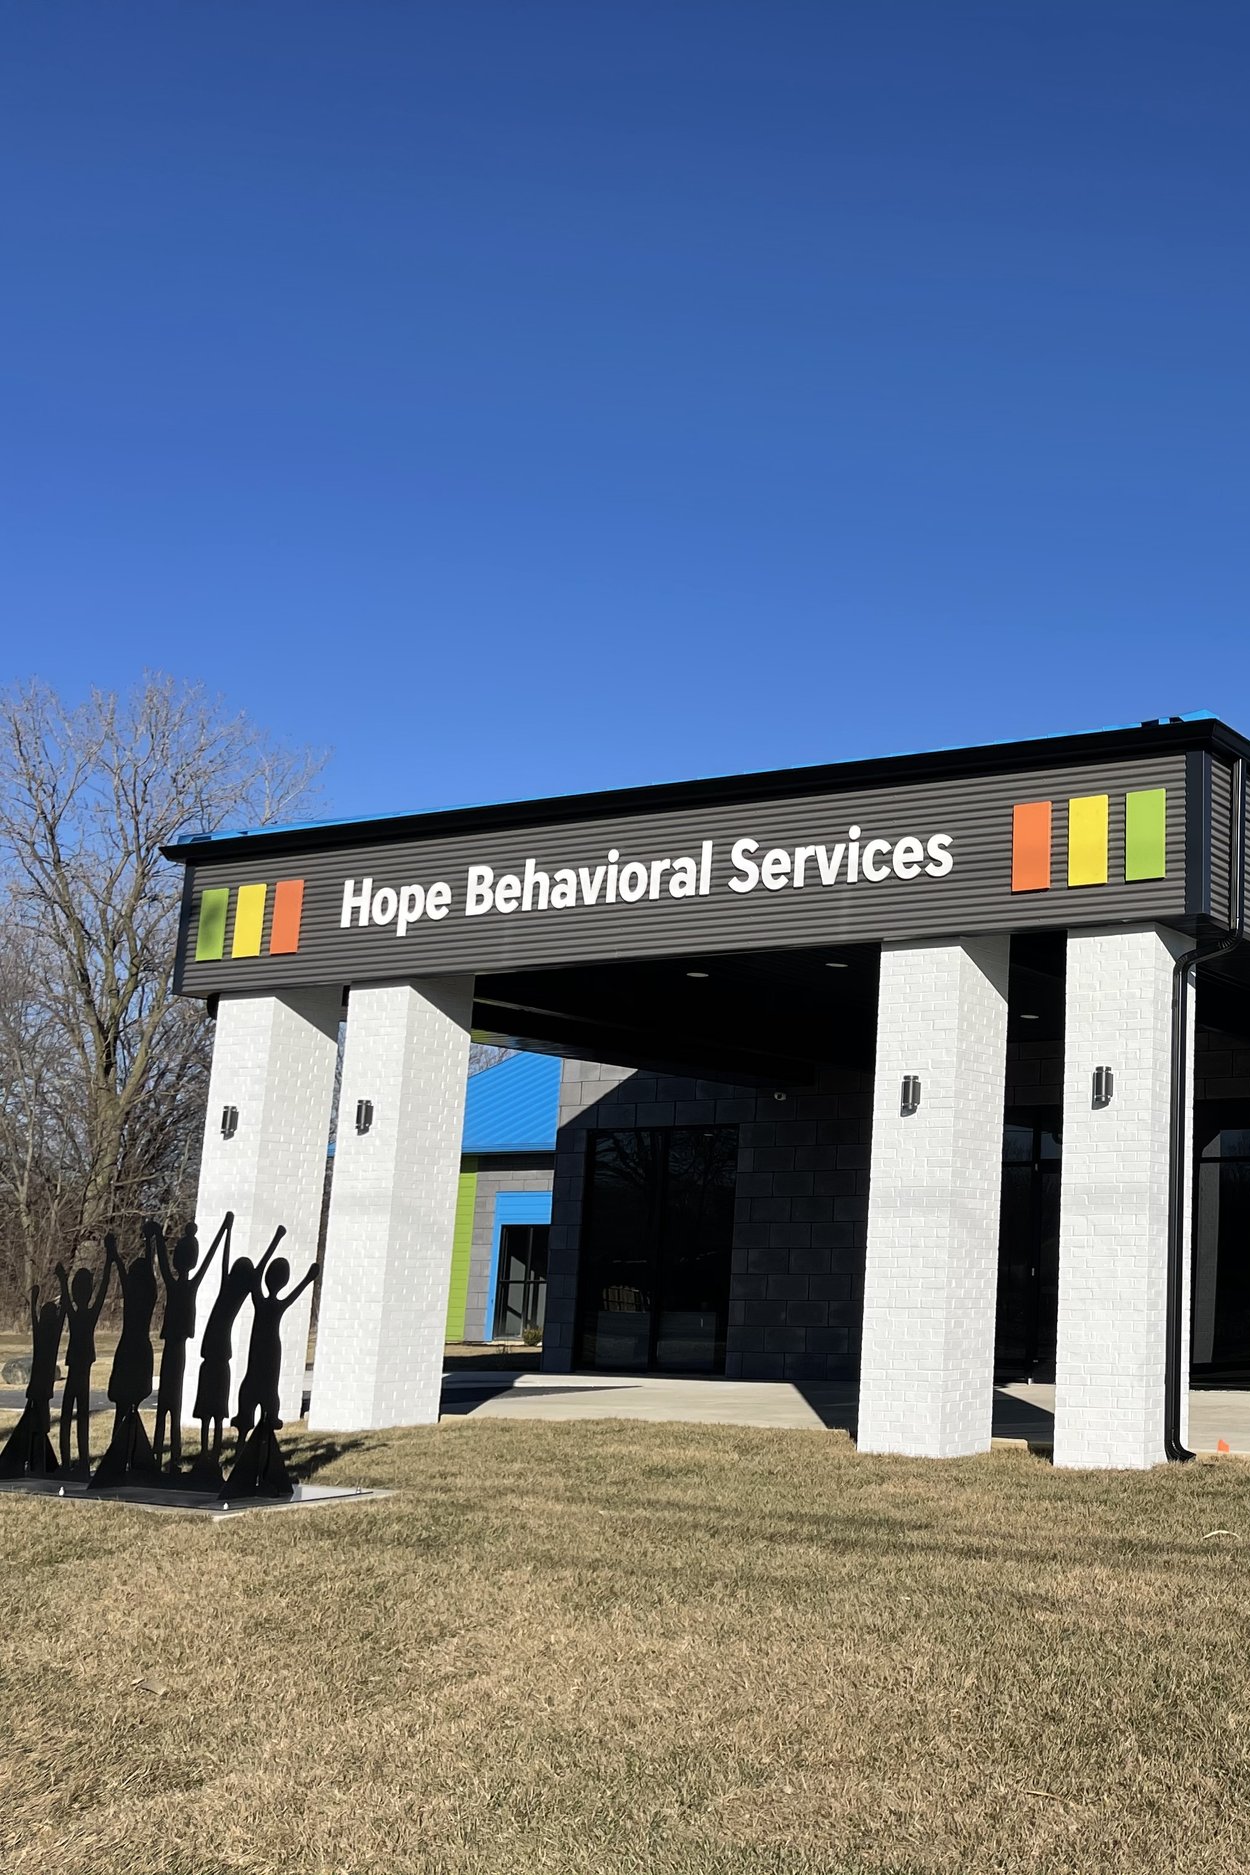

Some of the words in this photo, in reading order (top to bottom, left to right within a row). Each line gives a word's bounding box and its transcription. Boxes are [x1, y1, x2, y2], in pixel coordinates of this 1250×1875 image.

[340, 877, 451, 937] Hope
[464, 840, 713, 917] Behavioral
[727, 825, 954, 893] Services
